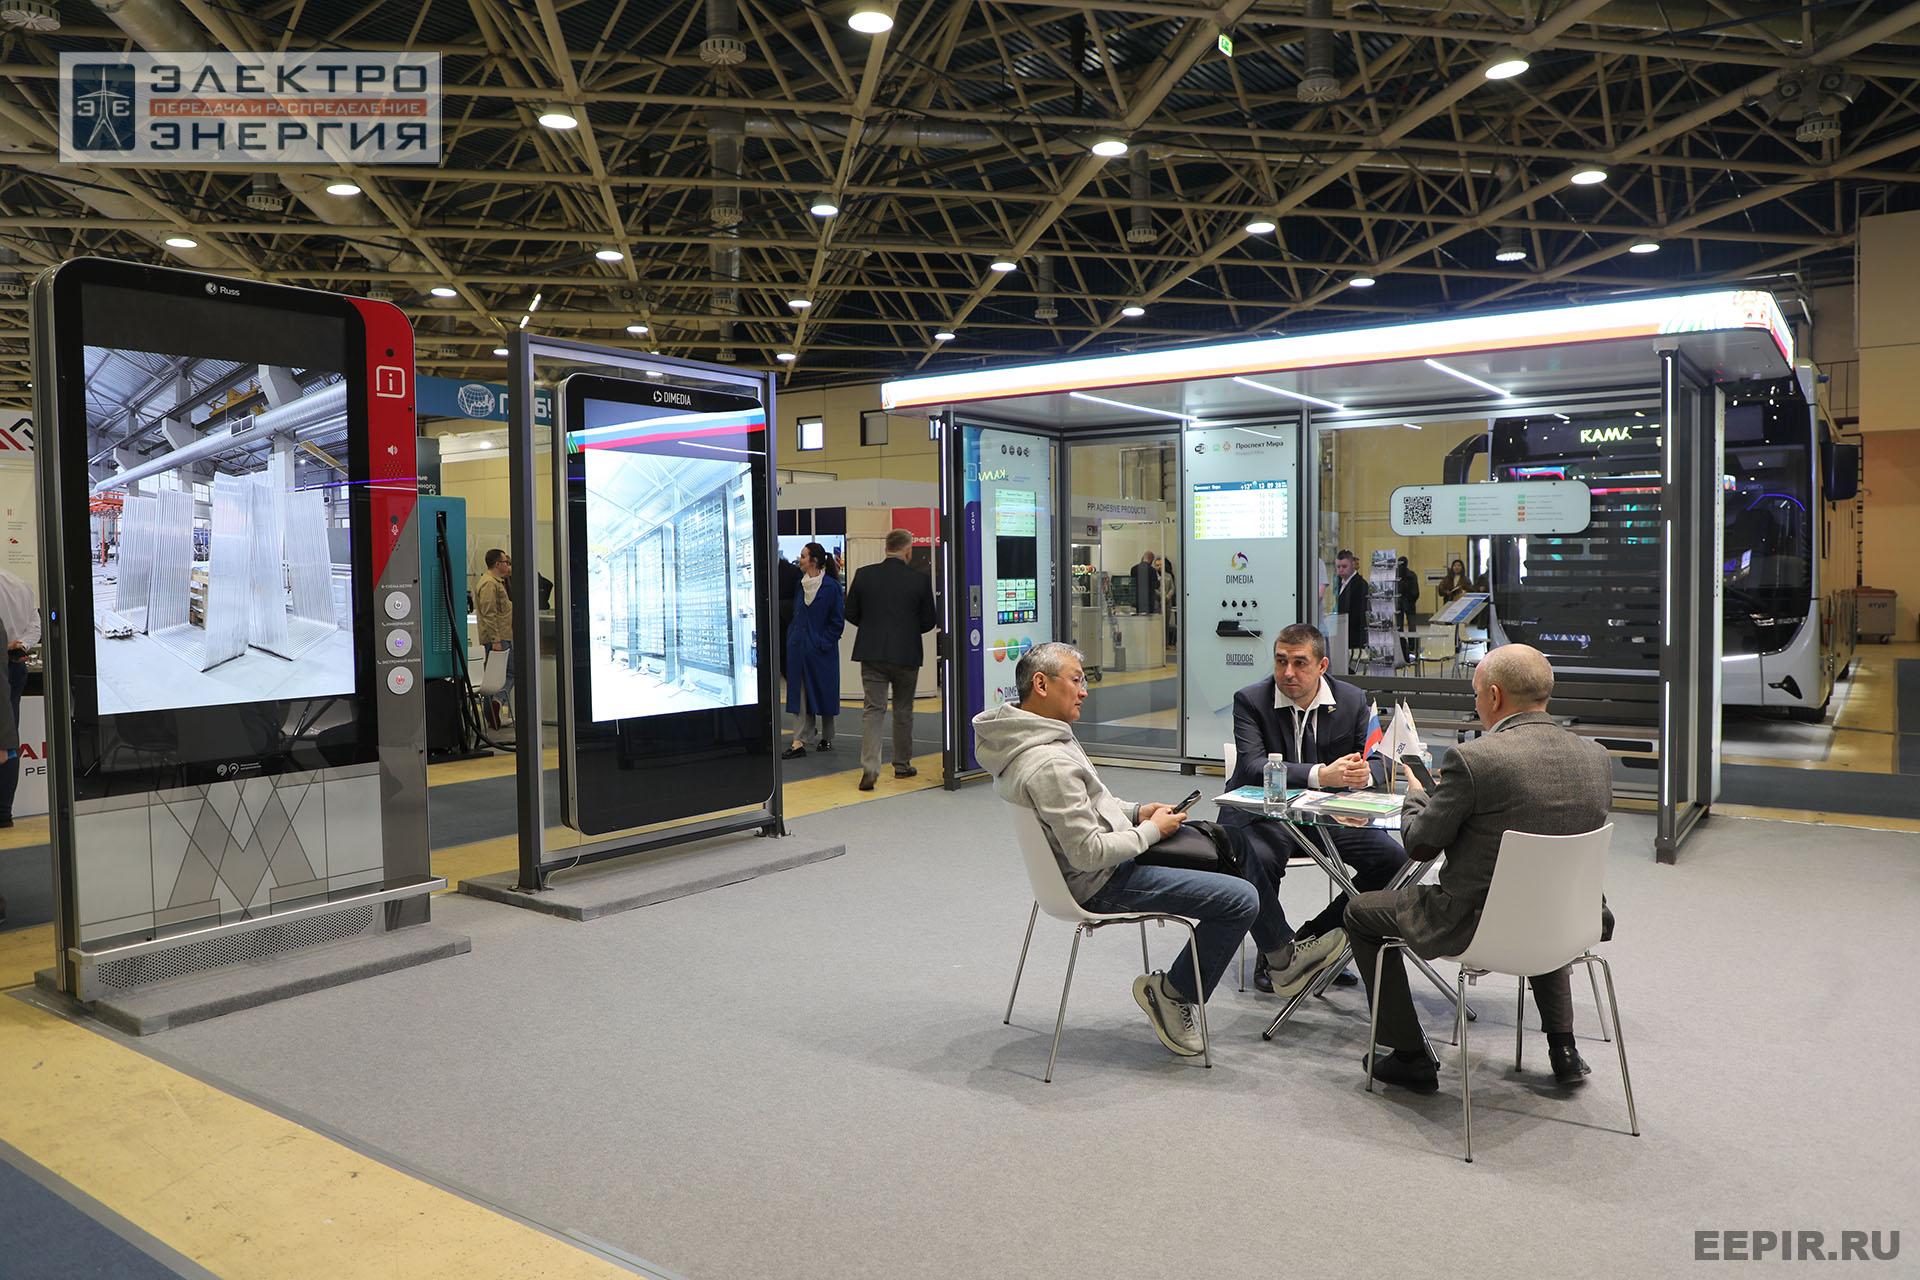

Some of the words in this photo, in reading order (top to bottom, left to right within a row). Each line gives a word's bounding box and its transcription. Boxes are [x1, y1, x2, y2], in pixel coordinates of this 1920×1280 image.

[219, 286, 241, 296] Russ
[663, 391, 692, 406] DIMEDIA
[1235, 442, 1265, 450] Проспект
[1266, 440, 1284, 449] Мира
[1096, 503, 1120, 513] ADHESIVE
[1121, 505, 1146, 515] PRODUCTS
[1225, 574, 1254, 584] DIMEDIA
[1226, 653, 1254, 663] OUTDOOR
[1005, 686, 1018, 698] DIME
